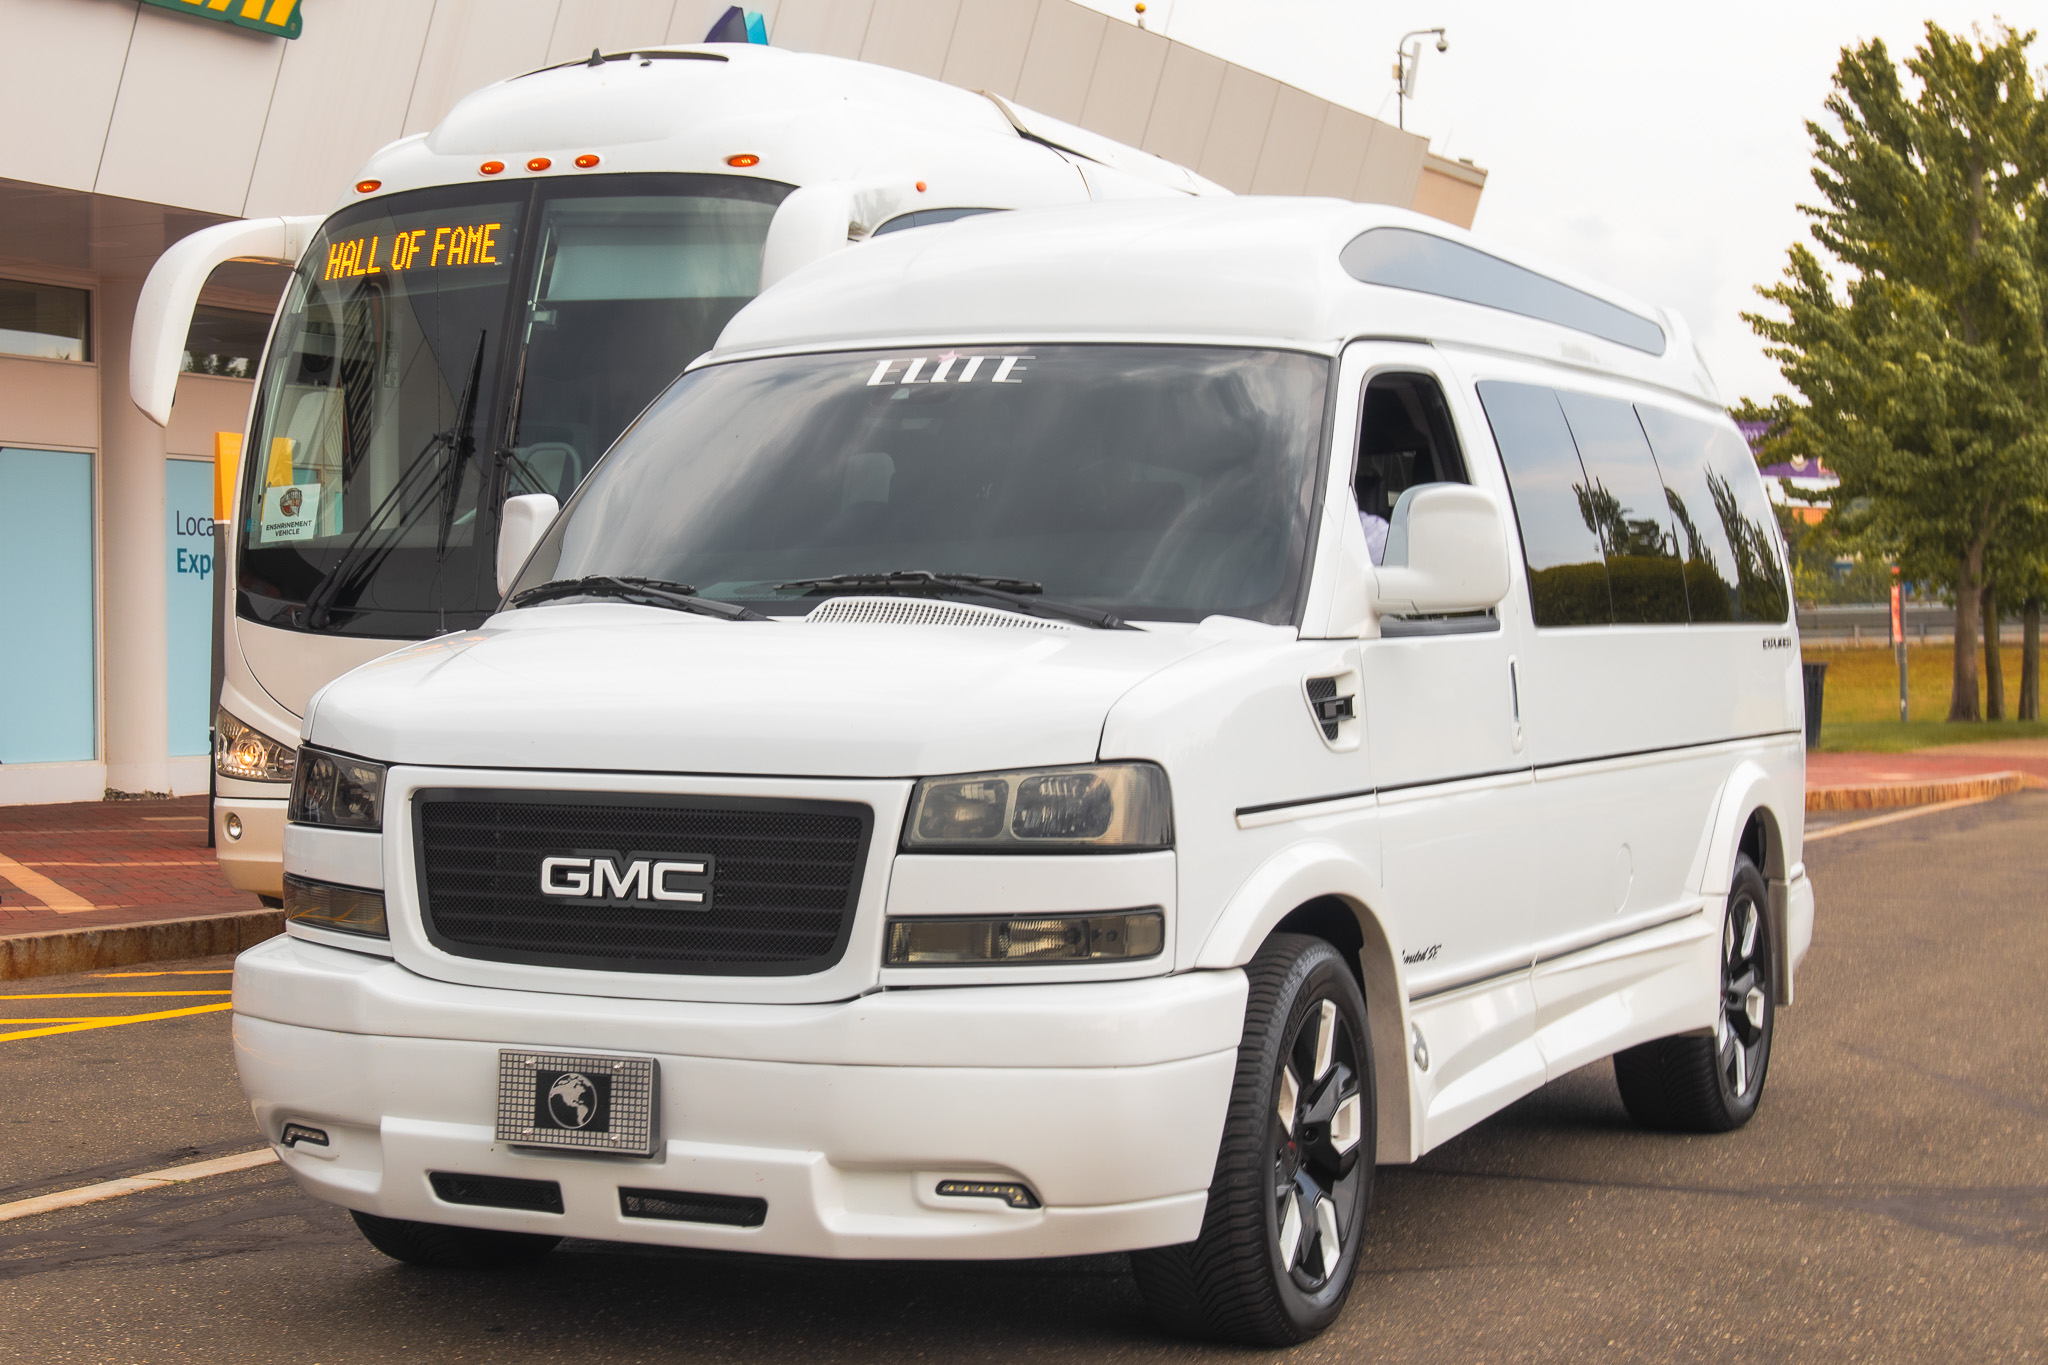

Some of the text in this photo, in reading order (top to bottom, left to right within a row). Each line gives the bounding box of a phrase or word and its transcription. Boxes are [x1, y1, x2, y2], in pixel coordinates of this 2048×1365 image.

[324, 223, 501, 281] HALL OF FAME
[866, 352, 1036, 386] ELITE
[265, 519, 312, 531] ENSHRINEMENT
[274, 528, 300, 537] VEHICLE
[176, 547, 214, 581] Exp
[541, 856, 707, 902] GMC
